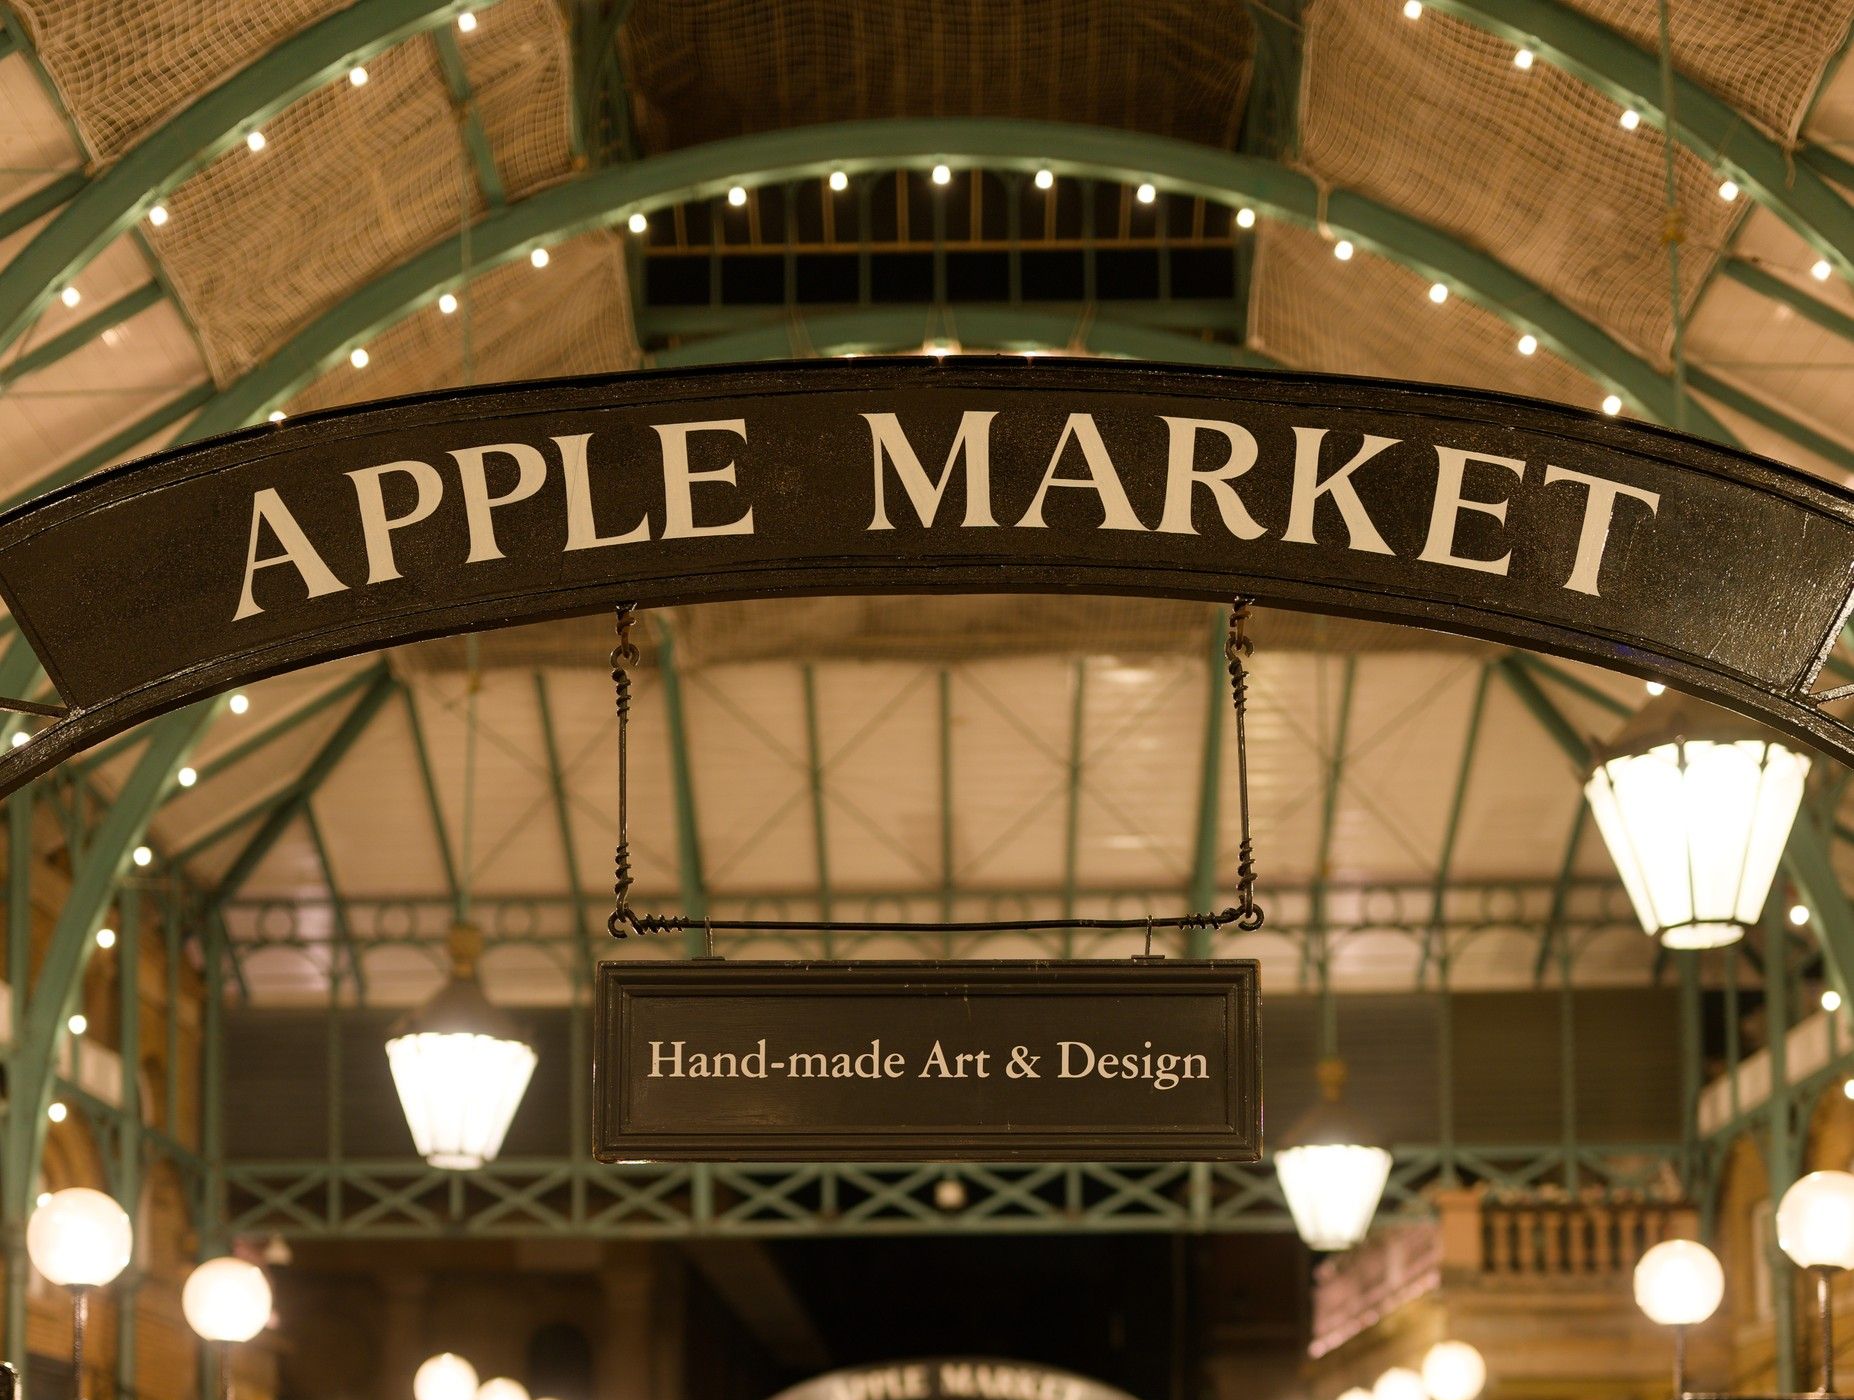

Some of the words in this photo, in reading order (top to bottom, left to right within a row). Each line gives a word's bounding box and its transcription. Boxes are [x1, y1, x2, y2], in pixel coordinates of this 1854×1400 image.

[231, 418, 756, 622] APPLE
[860, 410, 1661, 597] MARKET
[647, 1038, 905, 1079] Hand-made
[917, 1039, 991, 1078] Art
[1005, 1045, 1041, 1079] &
[1056, 1041, 1210, 1090] Design
